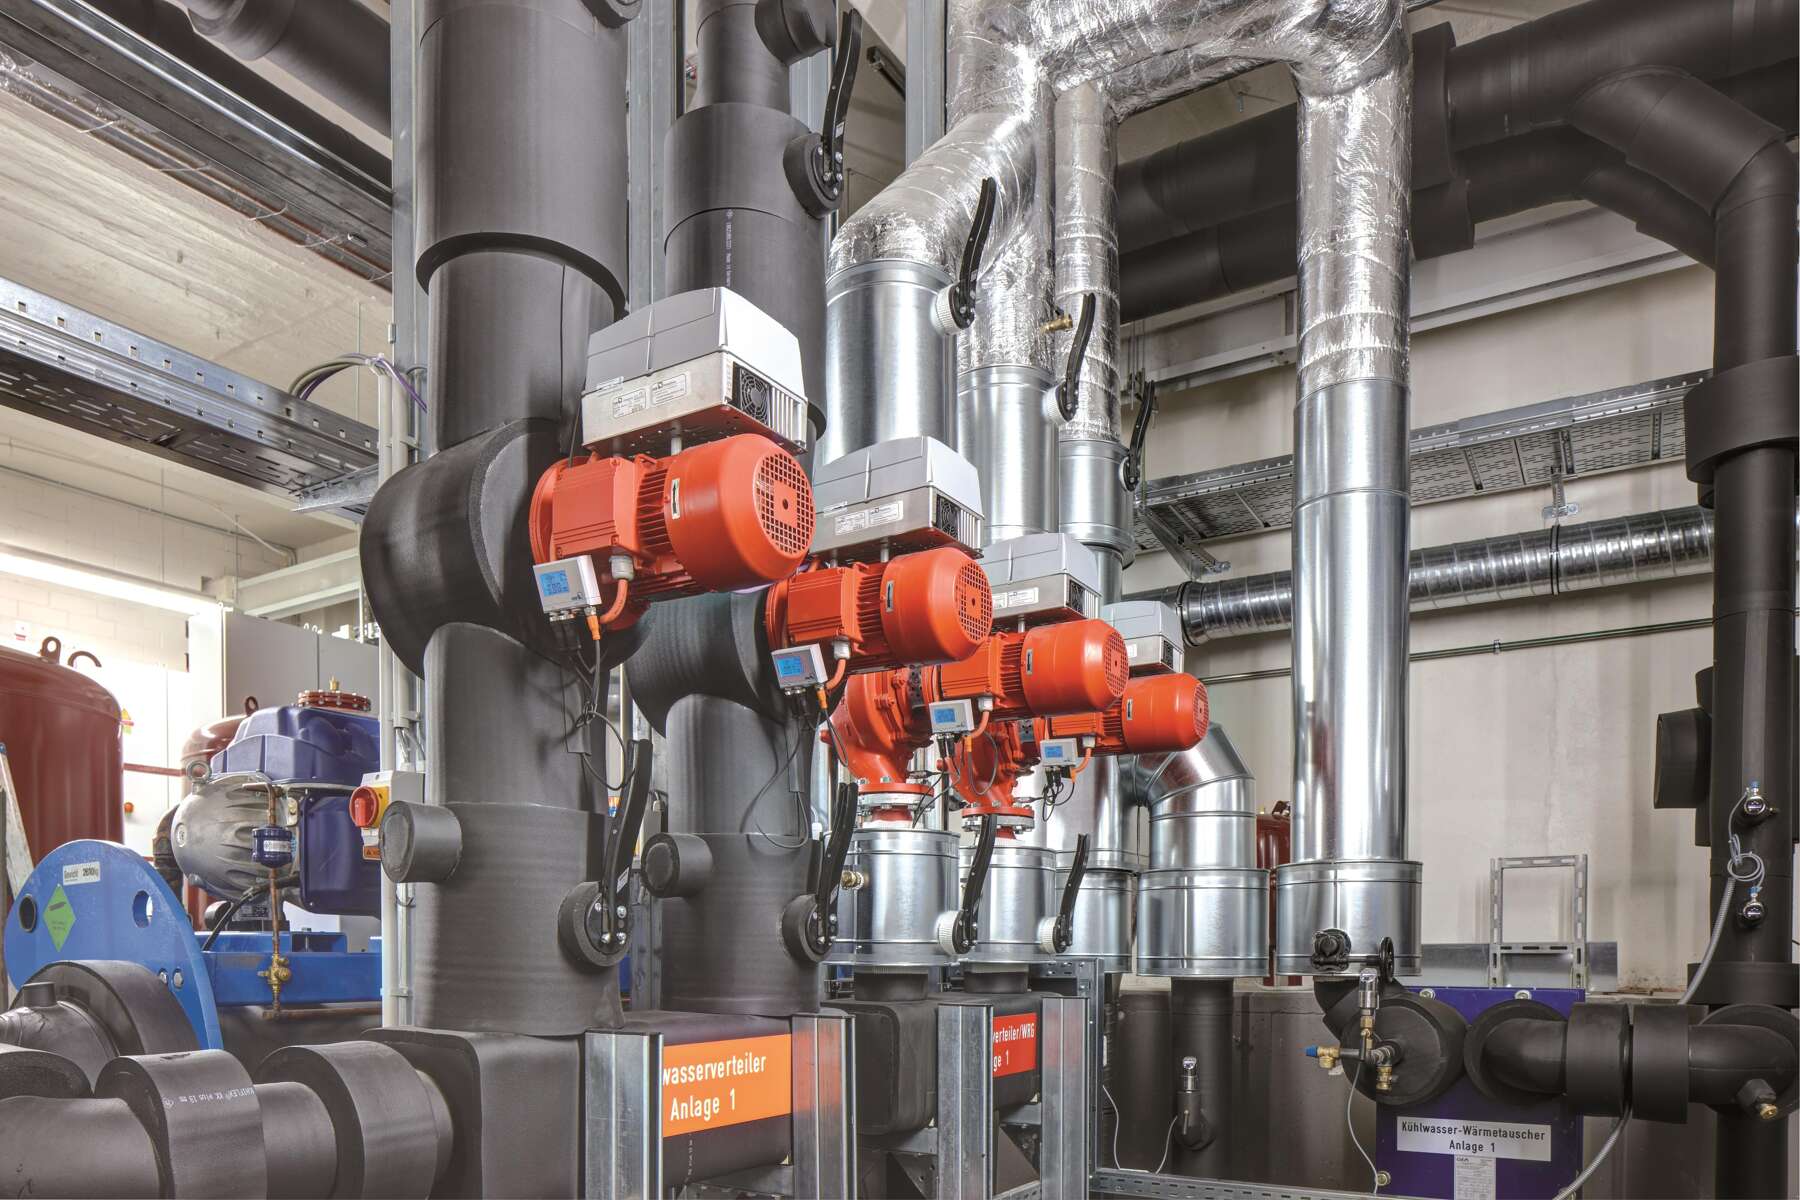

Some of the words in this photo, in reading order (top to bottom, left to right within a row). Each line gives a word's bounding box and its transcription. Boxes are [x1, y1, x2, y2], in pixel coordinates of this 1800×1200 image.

[670, 1094, 720, 1122] Anlage
[730, 1087, 736, 1111] 1
[1402, 1121, 1545, 1140] Kühlwasser-Wärmetauscher
[1449, 1140, 1484, 1153] Anlage
